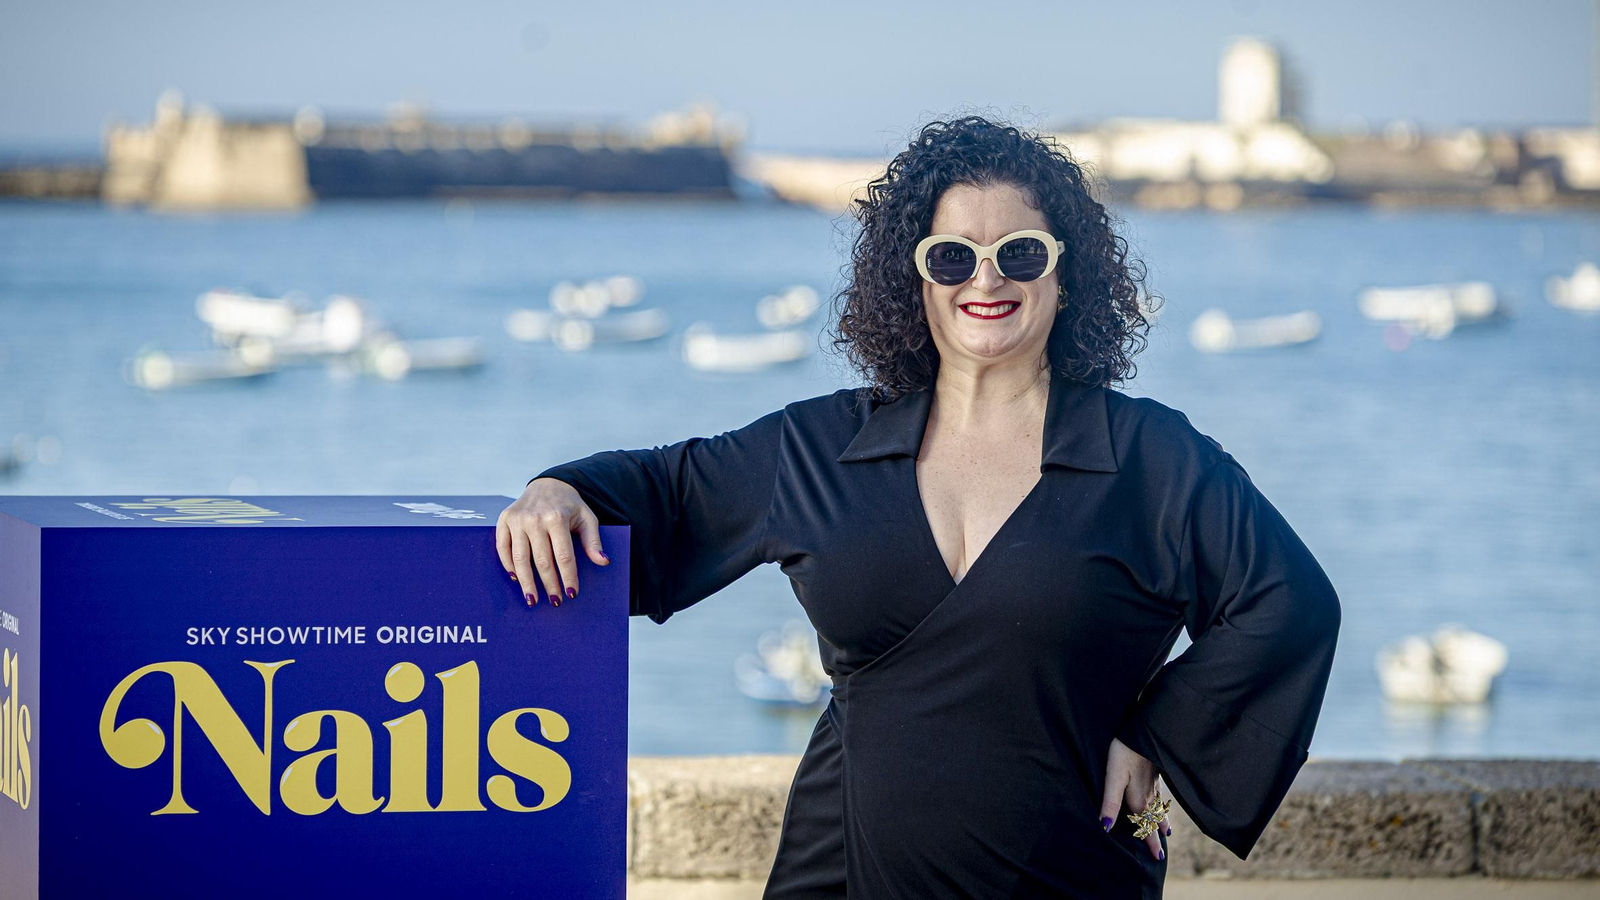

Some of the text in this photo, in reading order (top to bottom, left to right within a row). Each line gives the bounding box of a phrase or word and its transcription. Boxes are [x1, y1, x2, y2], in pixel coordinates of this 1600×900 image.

[186, 625, 488, 646] SKY SHOWTIME ORIGINAL
[0, 647, 31, 810] ils
[99, 659, 572, 816] Nails
